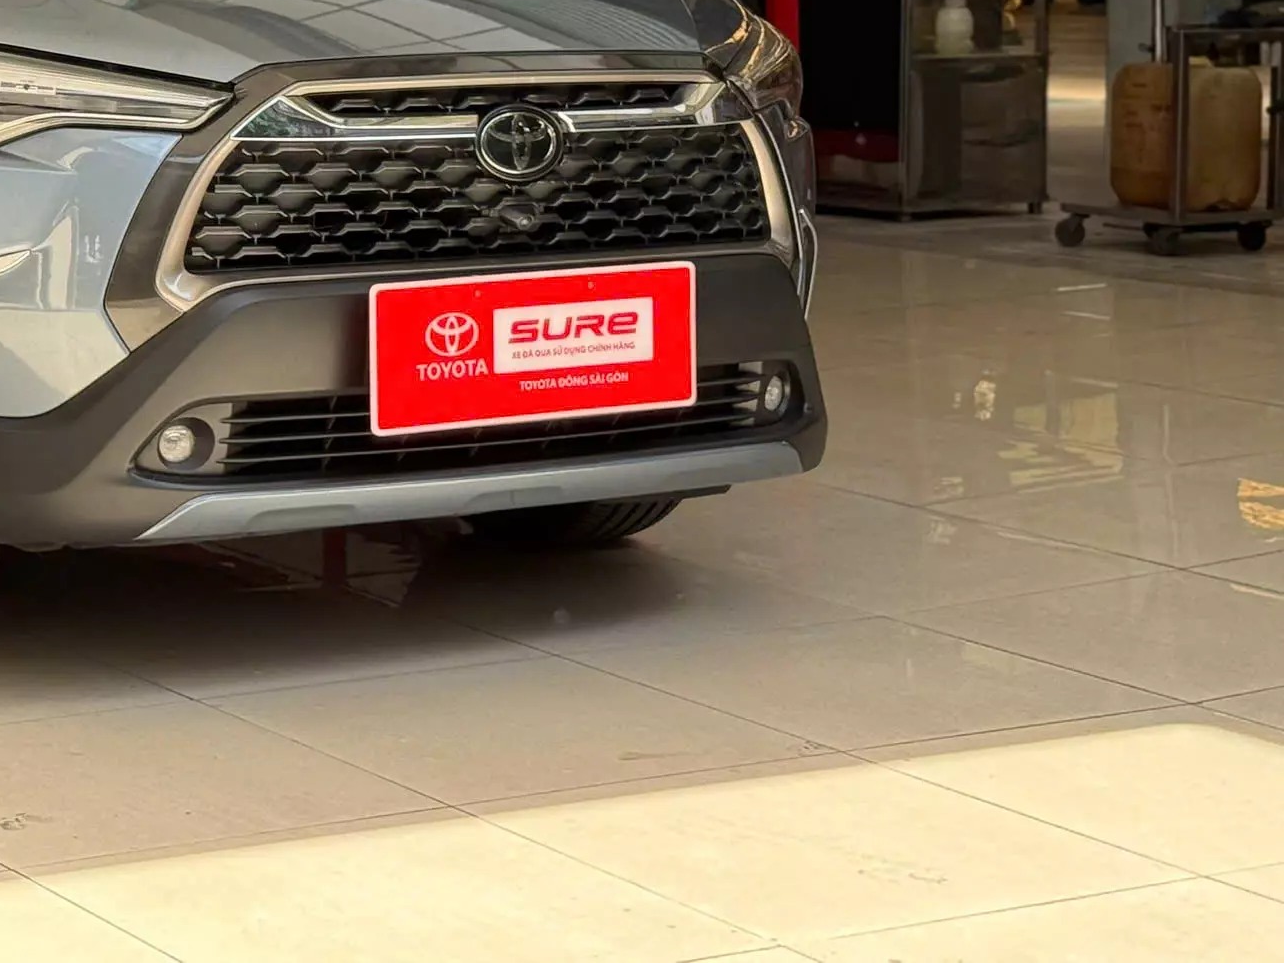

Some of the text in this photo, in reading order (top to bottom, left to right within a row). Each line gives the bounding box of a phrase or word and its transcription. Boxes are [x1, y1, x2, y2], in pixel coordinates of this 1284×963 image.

[512, 349, 522, 359] XE
[536, 347, 552, 358] QUA
[416, 358, 489, 382] TOYOTA
[519, 380, 557, 391] TOYOTA
